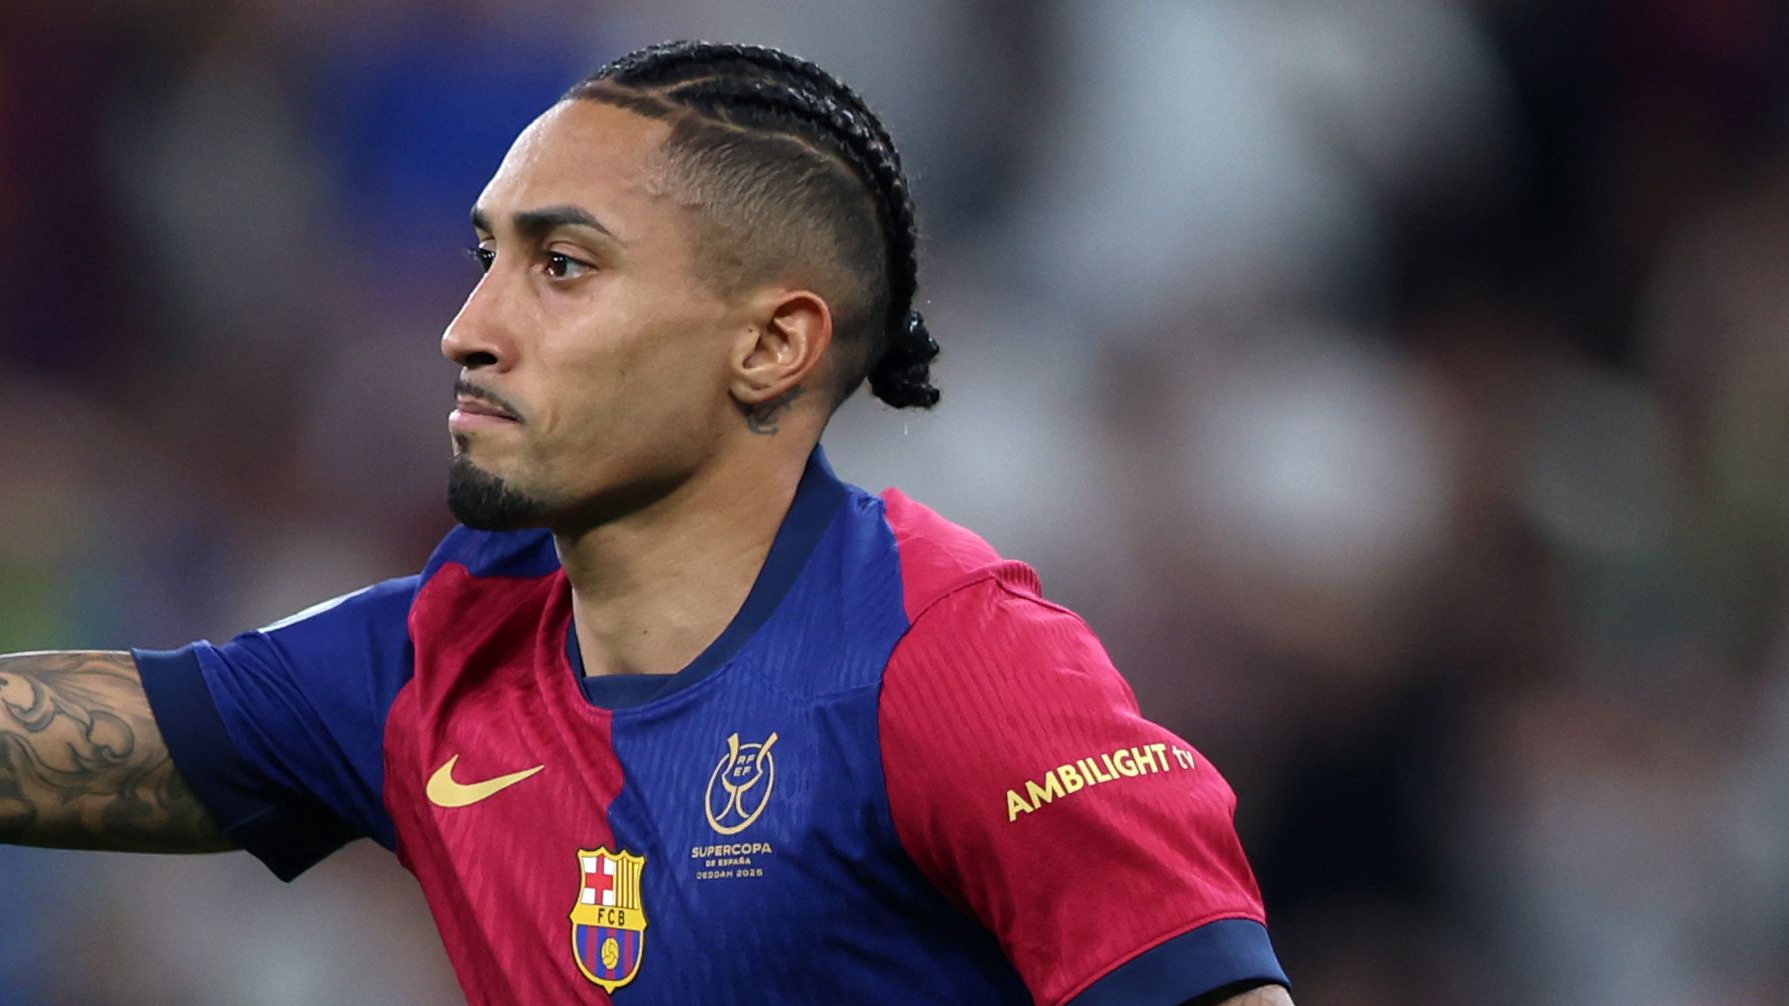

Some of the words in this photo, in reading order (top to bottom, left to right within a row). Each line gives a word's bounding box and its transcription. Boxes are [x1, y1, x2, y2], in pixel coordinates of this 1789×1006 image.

[737, 754, 756, 765] RF
[1006, 743, 1170, 822] AMBILIGHT
[1172, 745, 1195, 770] tv
[691, 842, 772, 858] SUPERCOPA
[718, 856, 751, 867] ESPAÑA
[597, 907, 626, 926] FCB
